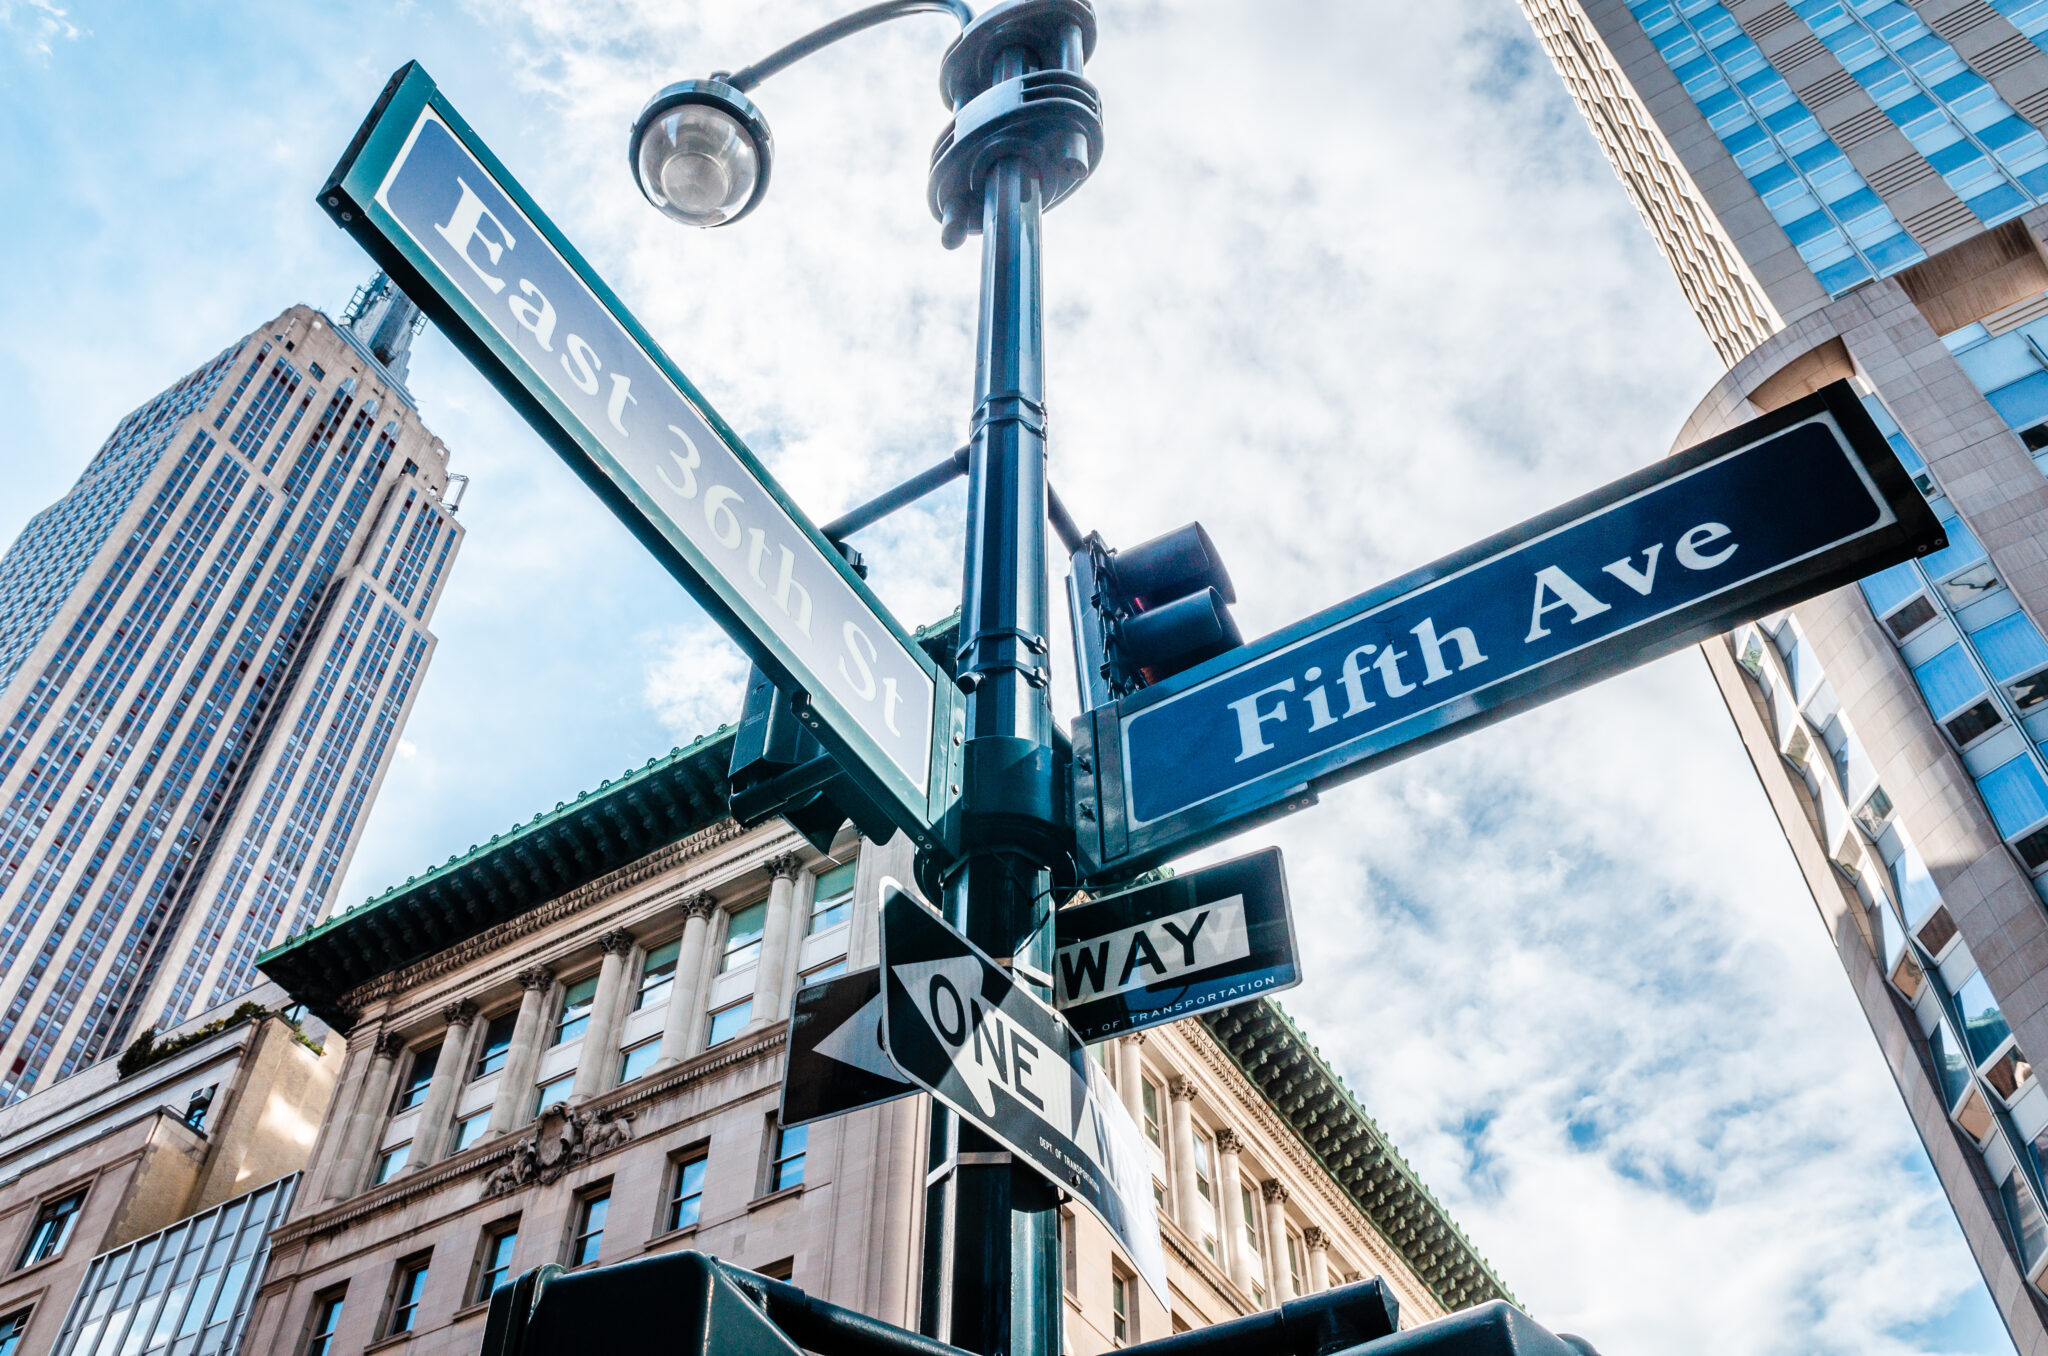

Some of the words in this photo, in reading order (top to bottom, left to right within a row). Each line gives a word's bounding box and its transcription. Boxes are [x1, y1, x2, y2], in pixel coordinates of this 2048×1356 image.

[434, 176, 638, 438] East
[655, 424, 813, 642] 36th
[838, 620, 904, 738] St
[1227, 616, 1488, 763] Fifth
[1524, 521, 1739, 644] Ave
[1060, 910, 1210, 1001] WAY
[1102, 1019, 1120, 1031] OF
[1129, 976, 1275, 1023] TRANSPORTATION
[929, 974, 1045, 1112] ONE
